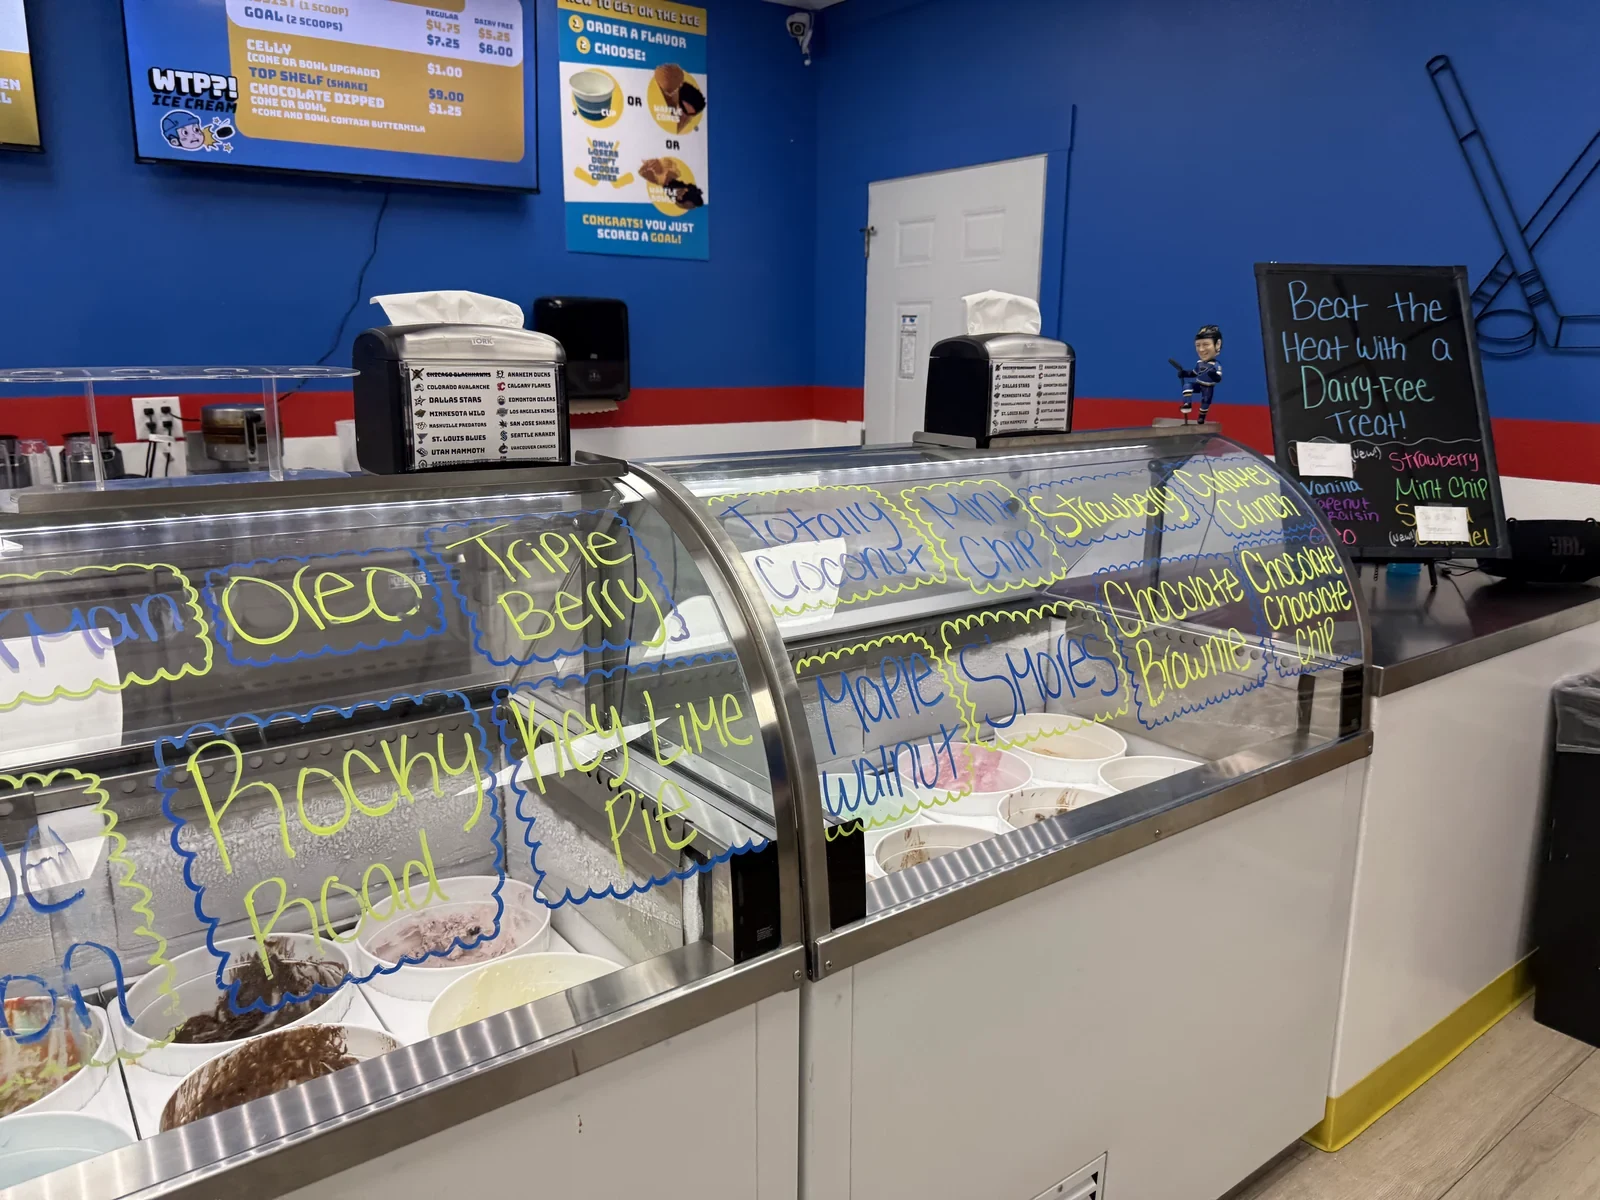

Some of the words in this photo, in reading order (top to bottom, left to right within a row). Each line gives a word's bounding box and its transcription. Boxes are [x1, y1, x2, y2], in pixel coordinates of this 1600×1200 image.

[244, 6, 284, 22] GOAL
[286, 14, 297, 25] (2
[299, 17, 343, 32] SCOOPS)
[312, 3, 349, 17] SCOOP)
[426, 9, 459, 21] REGULAR
[614, 2, 635, 14] GET
[638, 7, 654, 18] ON
[656, 10, 677, 22] THE
[680, 14, 700, 27] ICE
[426, 18, 461, 35] $4.75
[474, 17, 496, 28] DAIRY
[497, 22, 514, 30] FREE
[478, 27, 511, 43] $5.25
[586, 19, 628, 38] ORDER
[630, 28, 639, 41] A
[641, 30, 687, 49] FLAVOR
[246, 38, 292, 55] CELLY
[427, 34, 460, 49] $7.25
[478, 42, 514, 58] $8.00
[594, 42, 647, 62] CHOOSE:
[247, 52, 280, 65] (CONE
[282, 57, 297, 68] OR
[298, 59, 327, 72] BOWL
[329, 64, 380, 79] UPGRADE)
[427, 62, 463, 78] $1.00
[148, 67, 239, 101] WTP?!
[248, 66, 277, 80] TOP
[280, 71, 324, 86] SHELF
[327, 78, 368, 92] (SHAKE)
[152, 94, 181, 108] ICE
[184, 97, 237, 114] CREAM
[250, 82, 332, 103] CHOCOLATE
[334, 92, 385, 109] DIPPED
[250, 95, 278, 108] CONE
[281, 99, 296, 110] OR
[297, 101, 327, 113] BOWL
[428, 87, 465, 103] $9.00
[628, 96, 642, 107] OR
[283, 110, 303, 121] AND
[304, 113, 330, 123] BOWL
[331, 116, 370, 128] CONTAIN
[371, 120, 426, 133] BUTTERMILK
[428, 101, 463, 117] $1.25
[588, 147, 619, 158] LOSERS
[592, 140, 614, 150] ONLY
[665, 139, 680, 150] OR
[588, 164, 620, 174] CHOOSE
[582, 214, 644, 229] CONGRATS!
[645, 219, 667, 231] YOU
[668, 222, 694, 233] JUST
[597, 228, 640, 242] SCORED
[641, 232, 649, 242] A
[650, 232, 682, 244] GOAL!
[1288, 280, 1369, 322] Beat
[1387, 292, 1447, 323] the
[1282, 331, 1349, 364] Heat
[1431, 338, 1453, 362] a
[429, 396, 459, 404] DALLAS
[1300, 365, 1436, 410] Dairy-Free
[1325, 410, 1407, 439] Treat!
[450, 447, 486, 455] MAMMOTH
[1389, 449, 1480, 472] Strawberry
[1174, 464, 1280, 498] Caramel
[1299, 480, 1364, 496] Vanilla
[1395, 477, 1442, 501] Mint
[1449, 476, 1489, 501] Chip
[919, 490, 1020, 530] Mint
[1029, 485, 1190, 538] Strawberry
[1216, 492, 1302, 529] Crunch
[719, 499, 903, 551] Totally
[445, 524, 633, 582] Triple
[959, 529, 1043, 580] Chip
[1549, 535, 1586, 556] JBL
[755, 544, 924, 600] Coconut
[1240, 544, 1344, 595] Chocolate
[222, 565, 423, 645] Oreo
[497, 577, 668, 648] Berry
[1103, 567, 1246, 639] Chocolate
[1134, 627, 1253, 708] Brownie
[816, 652, 945, 756] Maple
[510, 690, 629, 795] Key
[186, 733, 483, 875] Rocky
[605, 780, 698, 876] Pie
[243, 829, 449, 980] Road
